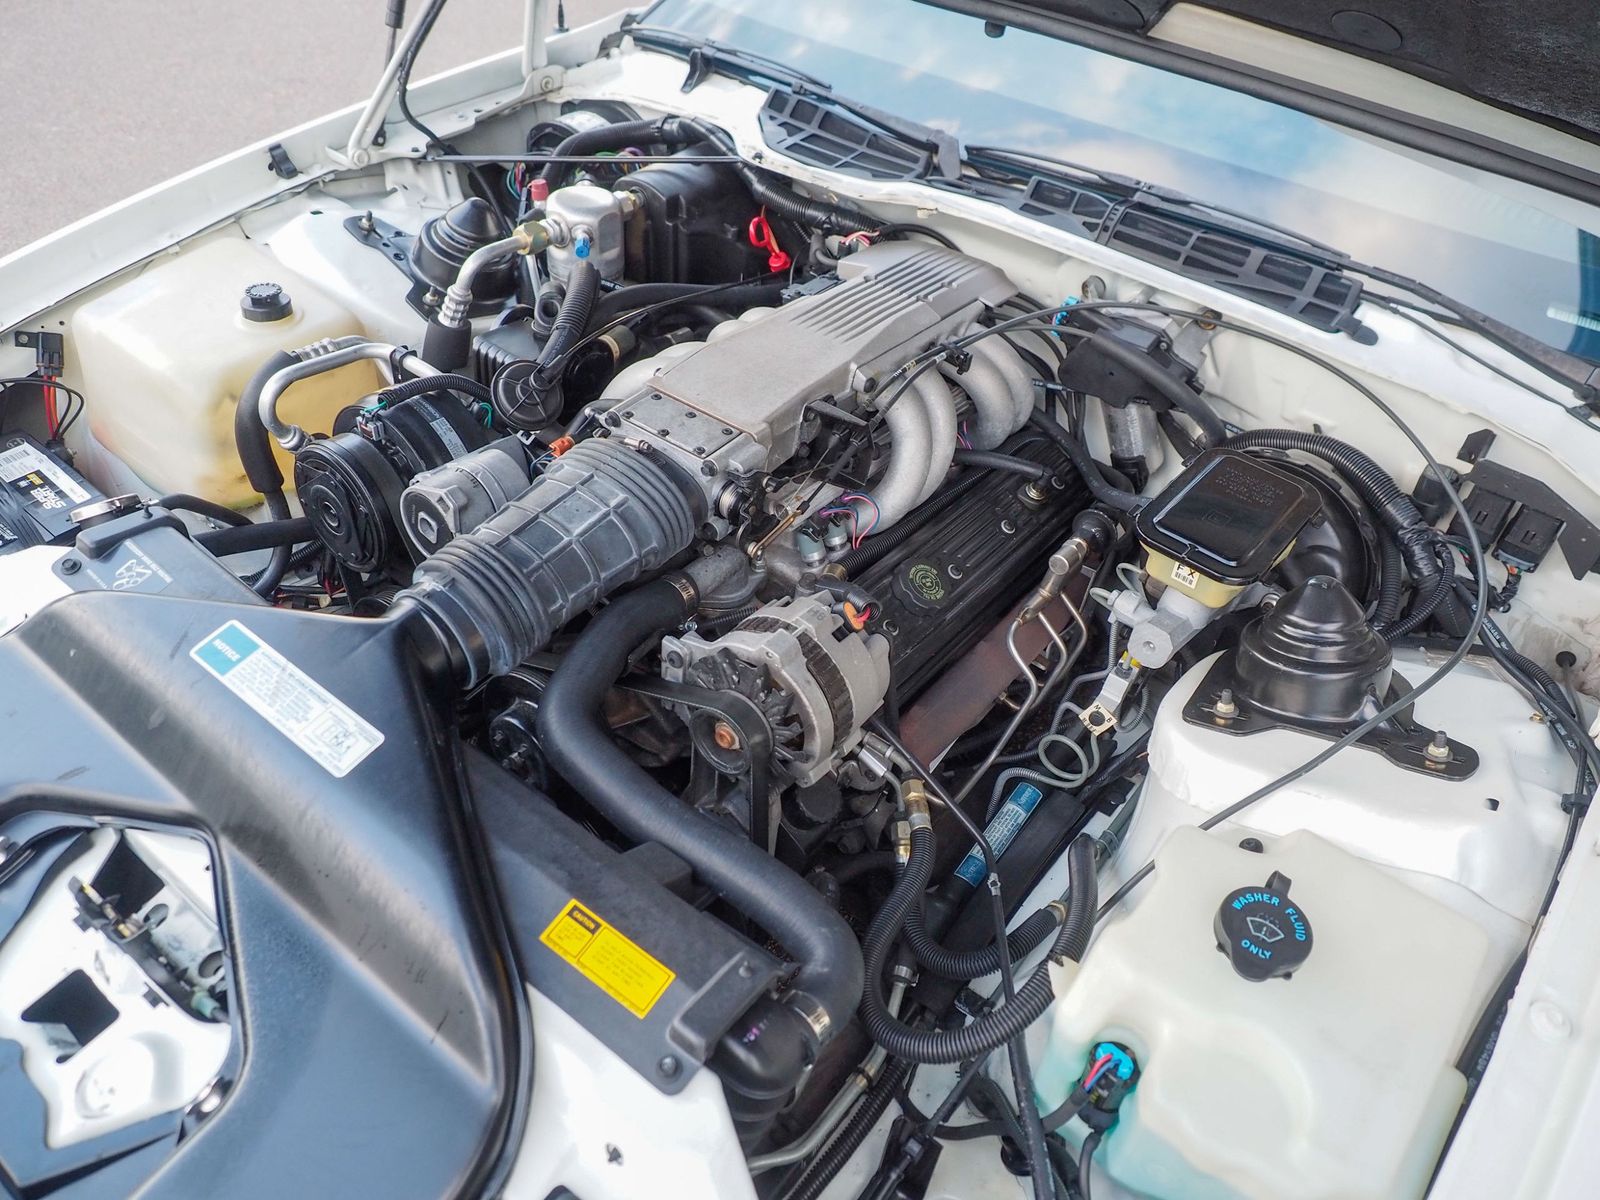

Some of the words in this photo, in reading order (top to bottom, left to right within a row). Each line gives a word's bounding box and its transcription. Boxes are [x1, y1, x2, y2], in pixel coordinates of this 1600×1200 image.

[30, 487, 52, 509] SUPER
[41, 485, 67, 509] START
[211, 638, 241, 662] NOTICE
[572, 910, 596, 930] CAUTION
[1231, 892, 1280, 911] WASHER
[1284, 906, 1307, 942] FLUID
[1241, 938, 1273, 960] ONLY
